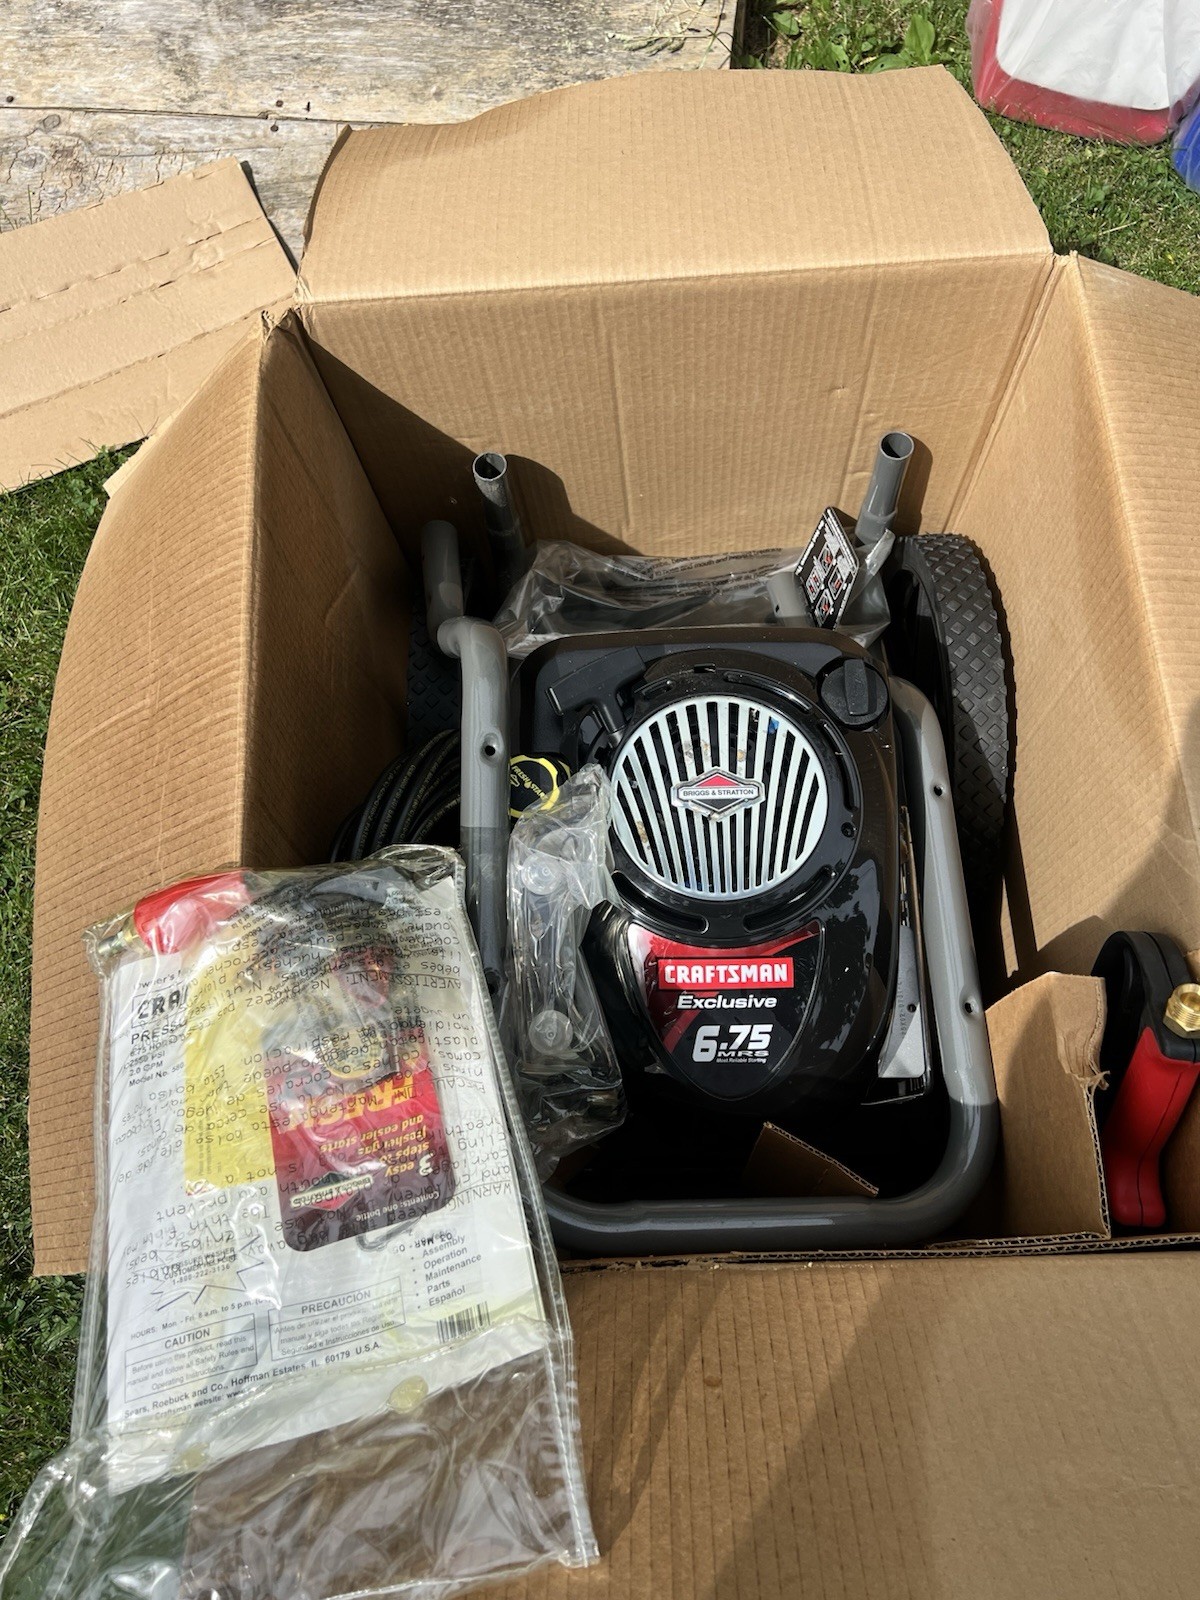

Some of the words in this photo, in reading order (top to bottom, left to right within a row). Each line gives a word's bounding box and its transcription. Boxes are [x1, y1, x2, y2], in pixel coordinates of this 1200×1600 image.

[664, 963, 788, 984] CRAFTSMAN
[677, 995, 777, 1009] Exclusive
[692, 1024, 774, 1062] 6.75
[129, 1073, 154, 1087] Model
[259, 1069, 332, 1098] corrales
[225, 1093, 245, 1107] de
[251, 1117, 291, 1132] esta
[401, 1113, 424, 1129] and
[360, 1123, 398, 1143] easier
[318, 1136, 357, 1155] starts
[398, 1141, 430, 1160] steps
[384, 1161, 415, 1178] easy
[418, 1152, 434, 1176] 3
[382, 1203, 398, 1213] one
[400, 1190, 440, 1208] Contents:
[354, 1209, 381, 1222] bottle
[415, 1236, 434, 1248] MAR
[422, 1235, 466, 1258] Assembly
[423, 1247, 468, 1270] Operation
[425, 1254, 482, 1282] Maintenance
[427, 1279, 451, 1294] Parts
[428, 1285, 466, 1307] Español
[221, 1305, 229, 1313] to
[301, 1289, 371, 1315] PRECAUCIÓN
[164, 1327, 211, 1350] CAUTION
[234, 1335, 247, 1344] this
[280, 1334, 307, 1345] manual
[325, 1328, 371, 1346] Instrucciones
[370, 1324, 380, 1333] de
[195, 1353, 217, 1366] Safety
[218, 1348, 239, 1359] Rules
[240, 1345, 255, 1354] and
[124, 1406, 150, 1419] Sears,
[152, 1392, 190, 1410] Roebuck
[192, 1387, 208, 1398] and
[210, 1382, 229, 1392] Co.,
[231, 1371, 270, 1387] Hoffman
[325, 1351, 351, 1364] 60179
[355, 1341, 382, 1356] U.S.A.
[151, 1375, 185, 1391] Operating
